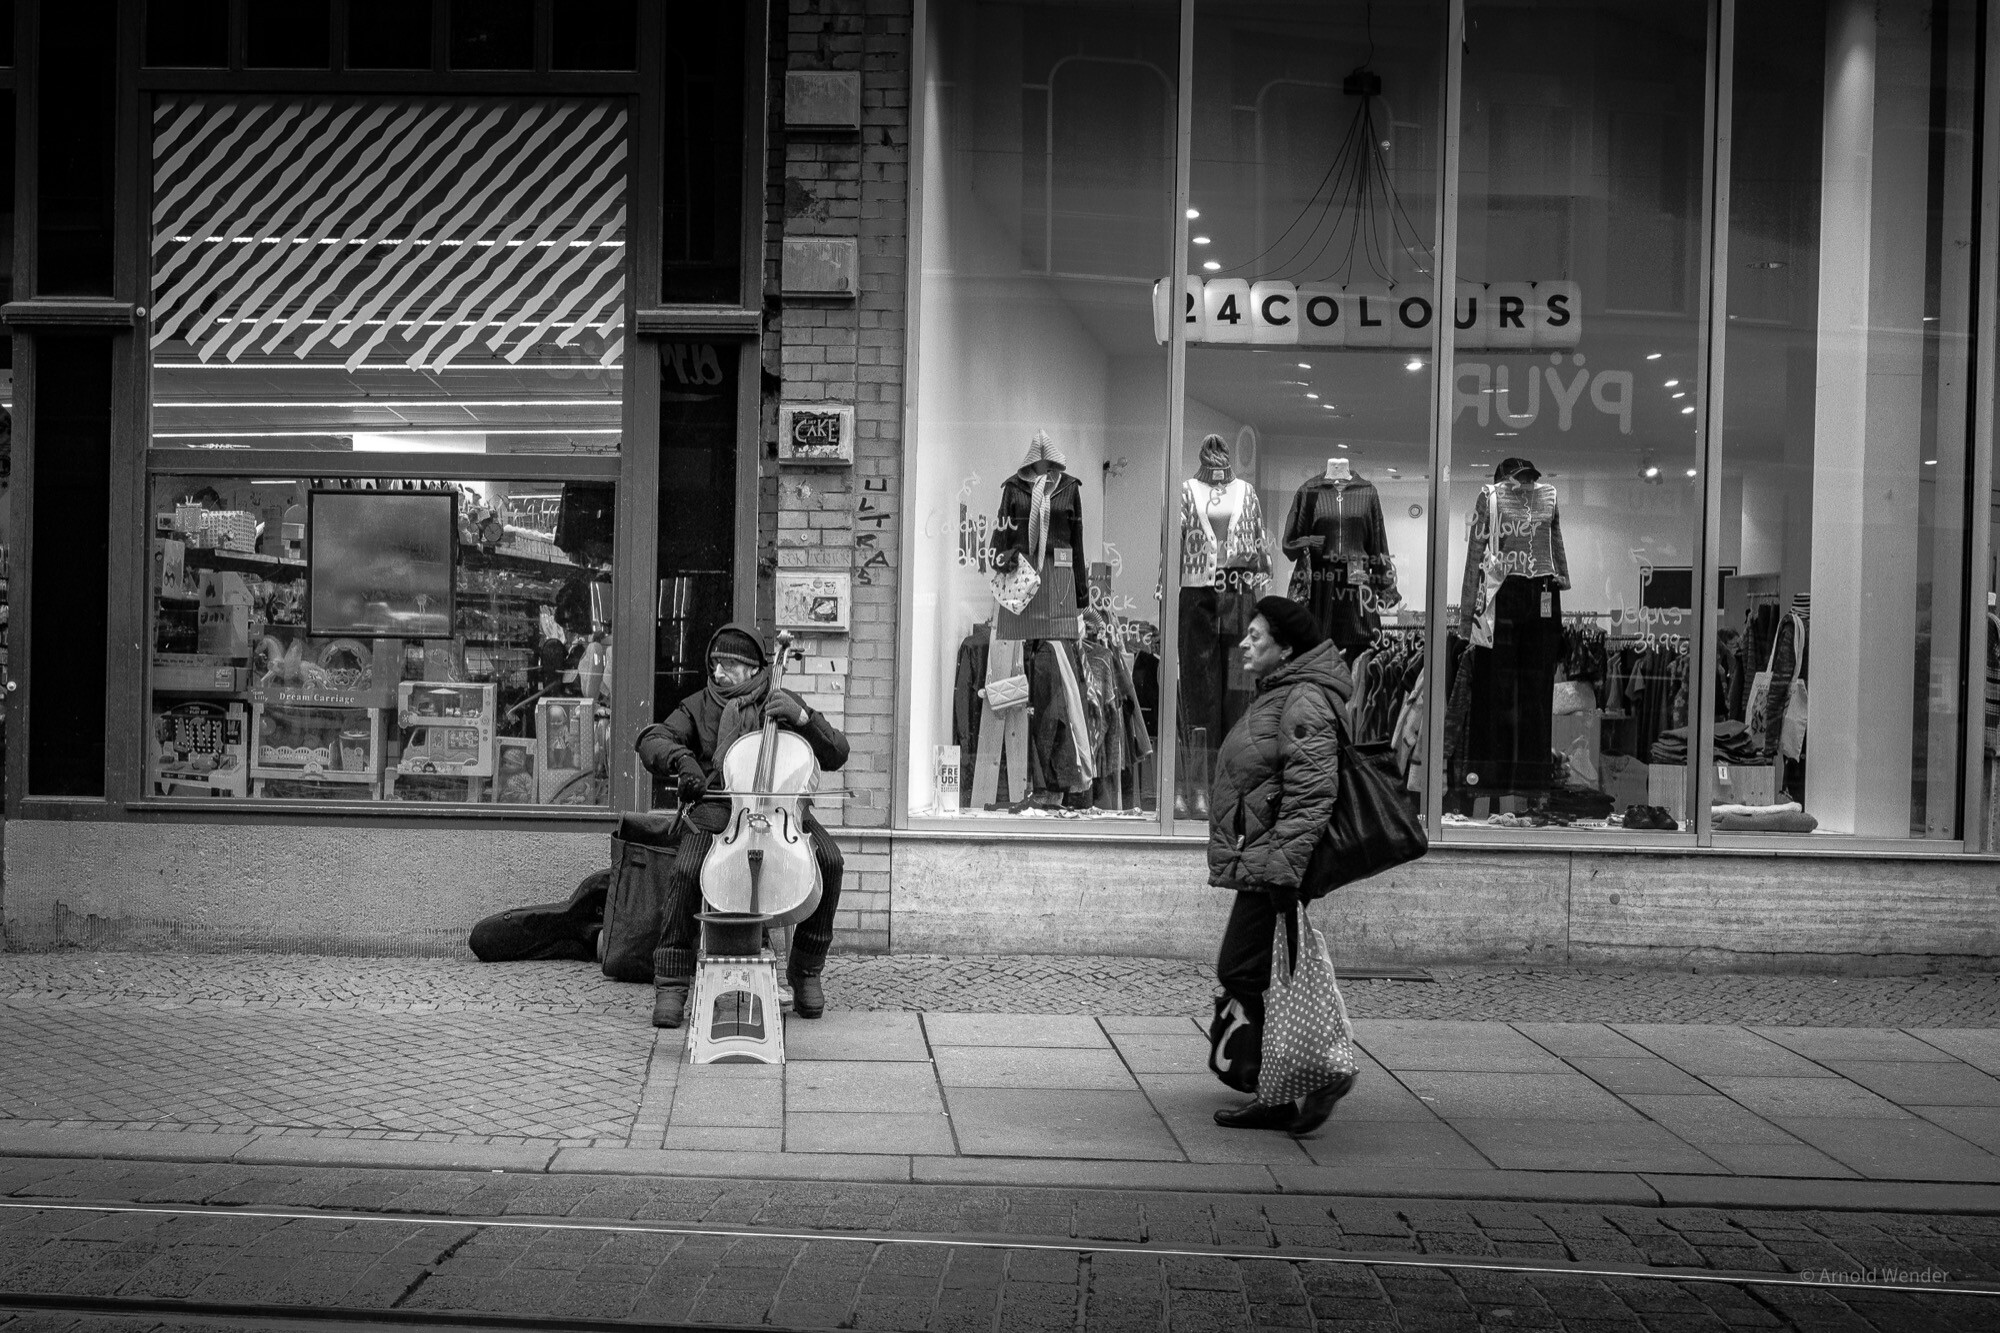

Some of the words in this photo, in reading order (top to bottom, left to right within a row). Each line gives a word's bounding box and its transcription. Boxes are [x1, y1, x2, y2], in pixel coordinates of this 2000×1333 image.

[855, 478, 891, 586] ULTRAS
[1464, 510, 1542, 542] Pullover
[1186, 529, 1280, 562] Cardigan
[1610, 592, 1682, 627] Jeans
[1633, 632, 1689, 655] 39,99€
[279, 692, 310, 701] Dream
[313, 693, 355, 704] Carriage
[941, 767, 958, 776] FRE
[941, 776, 958, 784] UDE
